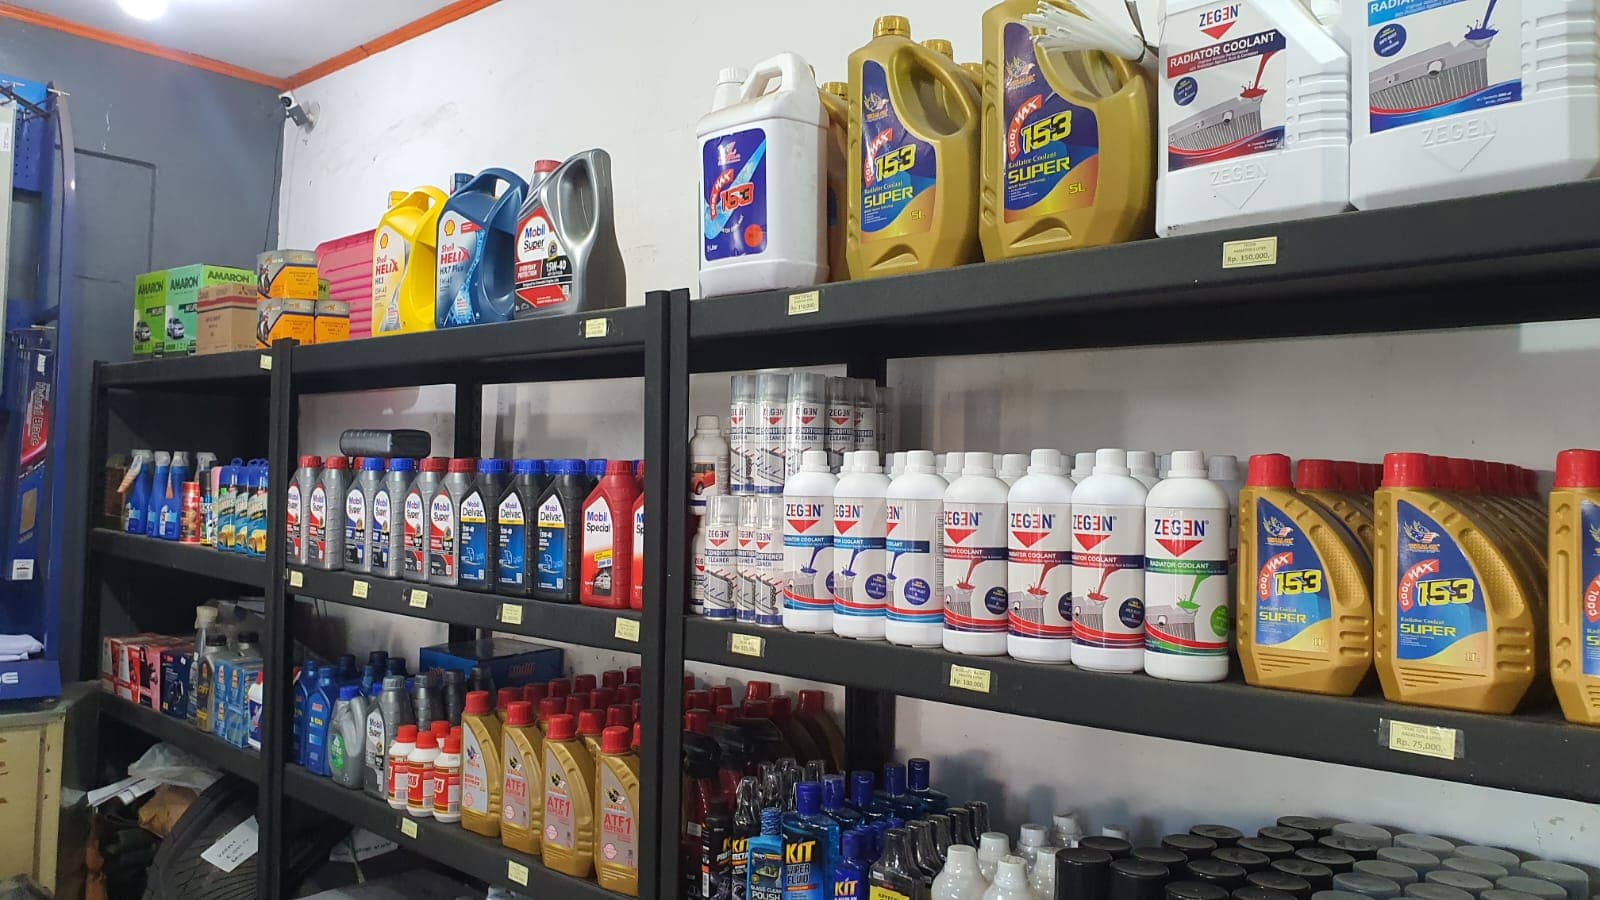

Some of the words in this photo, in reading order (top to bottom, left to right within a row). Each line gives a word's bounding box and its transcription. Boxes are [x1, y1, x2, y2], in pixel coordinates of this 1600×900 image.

[1199, 4, 1239, 27] ZEGEN
[1170, 47, 1221, 68] RADIATOR
[1223, 31, 1276, 54] COOLANT
[1009, 127, 1018, 155] COOL
[1015, 101, 1038, 125] MAX
[1020, 110, 1072, 154] 153
[875, 144, 916, 181] 153
[1008, 157, 1070, 184] SUPER
[1068, 183, 1086, 194] 5L
[721, 182, 754, 213] 153
[864, 186, 914, 209] SUPER
[524, 223, 545, 240] Mobil
[524, 239, 545, 251] Super
[375, 259, 399, 276] HELIX
[170, 275, 199, 291] AMARON
[207, 270, 250, 284] AMARON
[138, 280, 164, 295] AMARON
[406, 501, 420, 510] Mobil
[433, 503, 450, 512] Mobil
[462, 507, 484, 517] Delvac
[786, 504, 822, 517] ZEGEN
[835, 504, 860, 518] EGEN
[433, 513, 450, 522] Super
[501, 509, 521, 518] Delvac
[539, 512, 562, 522] Delvac
[587, 511, 608, 522] Mobil
[944, 511, 980, 526] ZEGEN
[1011, 513, 1053, 529] ZEGEN
[586, 523, 611, 533] Special
[1073, 514, 1113, 531] ZEGEN
[1154, 519, 1206, 537] ZEGEN
[1088, 555, 1117, 563] COOLANT
[1178, 561, 1209, 569] COOLANT
[1260, 572, 1270, 595] COOL
[1266, 555, 1289, 572] MAX
[1273, 569, 1322, 596] 153
[1401, 582, 1410, 606] COOL
[1407, 563, 1434, 581] MAX
[1416, 577, 1474, 607] 153
[1588, 590, 1599, 616] COOL
[1259, 611, 1307, 624] SUPER
[1400, 623, 1456, 637] SUPER
[1396, 737, 1411, 747] Rp.
[786, 839, 816, 864] KIT
[787, 864, 810, 874] WIPER
[787, 874, 809, 885] FLUID
[751, 891, 781, 900] POLISH
[834, 880, 858, 897] KIT
